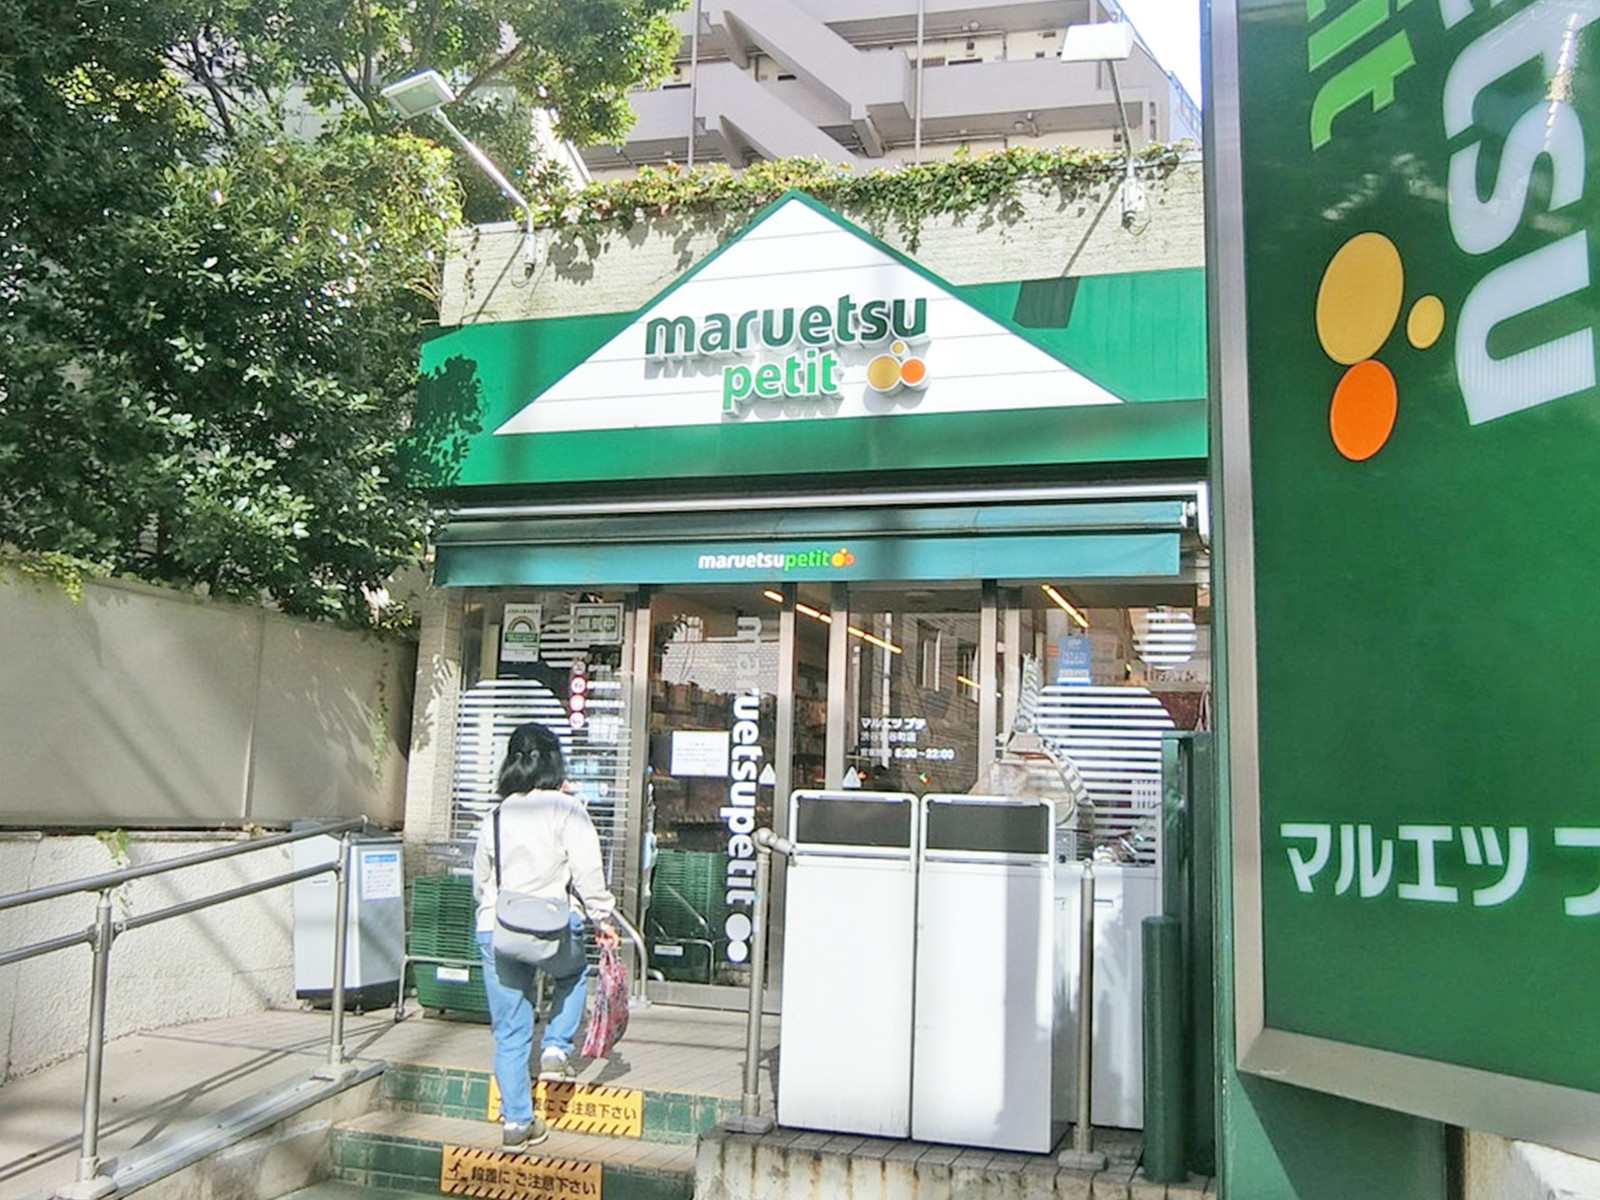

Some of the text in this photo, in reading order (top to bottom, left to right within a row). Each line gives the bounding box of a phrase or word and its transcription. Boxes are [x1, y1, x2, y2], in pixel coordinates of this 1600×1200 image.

[1306, 0, 1417, 151] it
[1438, 0, 1600, 426] tsu
[645, 294, 927, 355] maruetsu
[722, 350, 838, 411] petit
[1280, 822, 1530, 907] マルエツ
